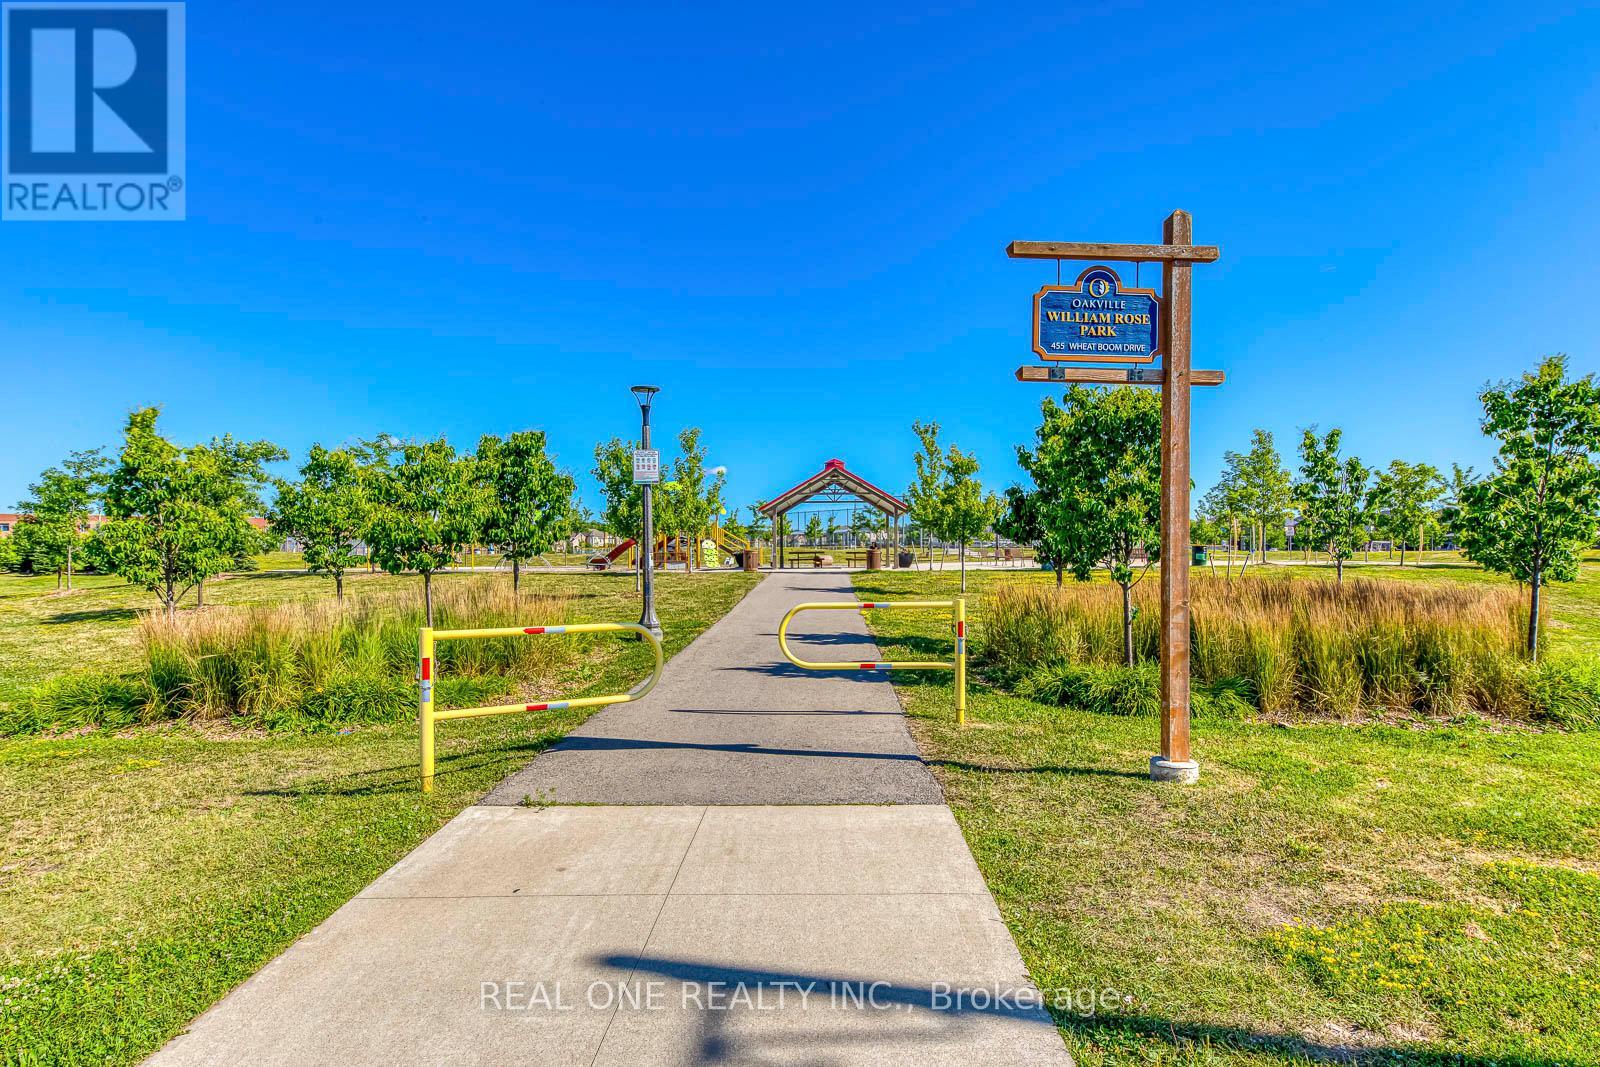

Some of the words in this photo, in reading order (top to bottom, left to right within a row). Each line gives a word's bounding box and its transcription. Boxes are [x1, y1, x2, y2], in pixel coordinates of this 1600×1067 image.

[1072, 299, 1126, 309] OAKVILLE
[1047, 311, 1110, 323] WILLIAM
[1114, 314, 1150, 324] ROSE
[1080, 326, 1117, 336] PARK
